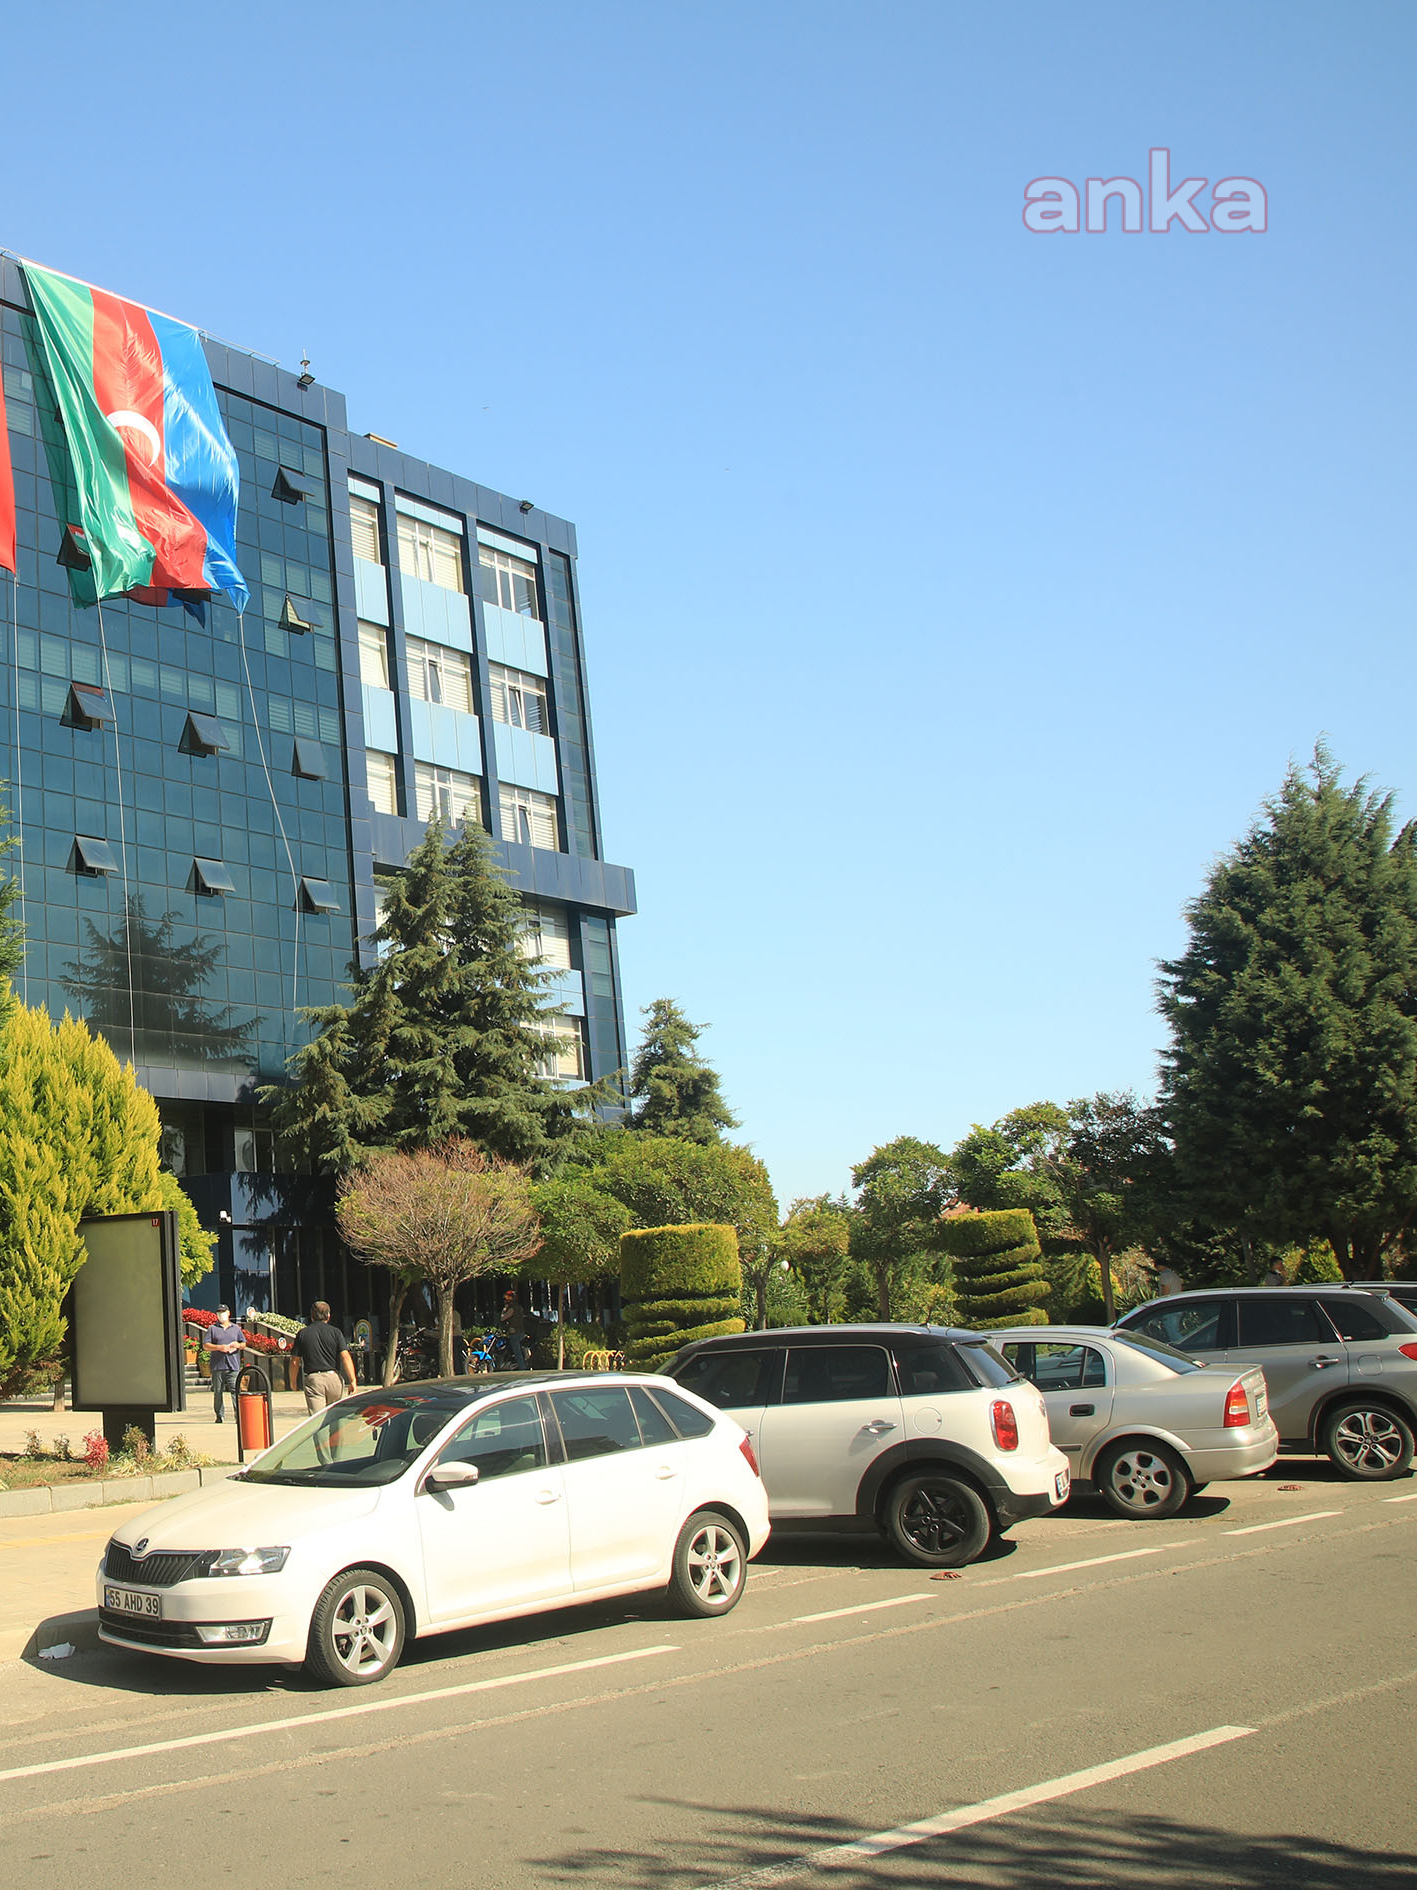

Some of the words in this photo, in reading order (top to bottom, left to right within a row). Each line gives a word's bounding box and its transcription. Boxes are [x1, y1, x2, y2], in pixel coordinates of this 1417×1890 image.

[109, 1590, 121, 1607] 55
[124, 1592, 143, 1612] AHD
[145, 1596, 159, 1615] 39
